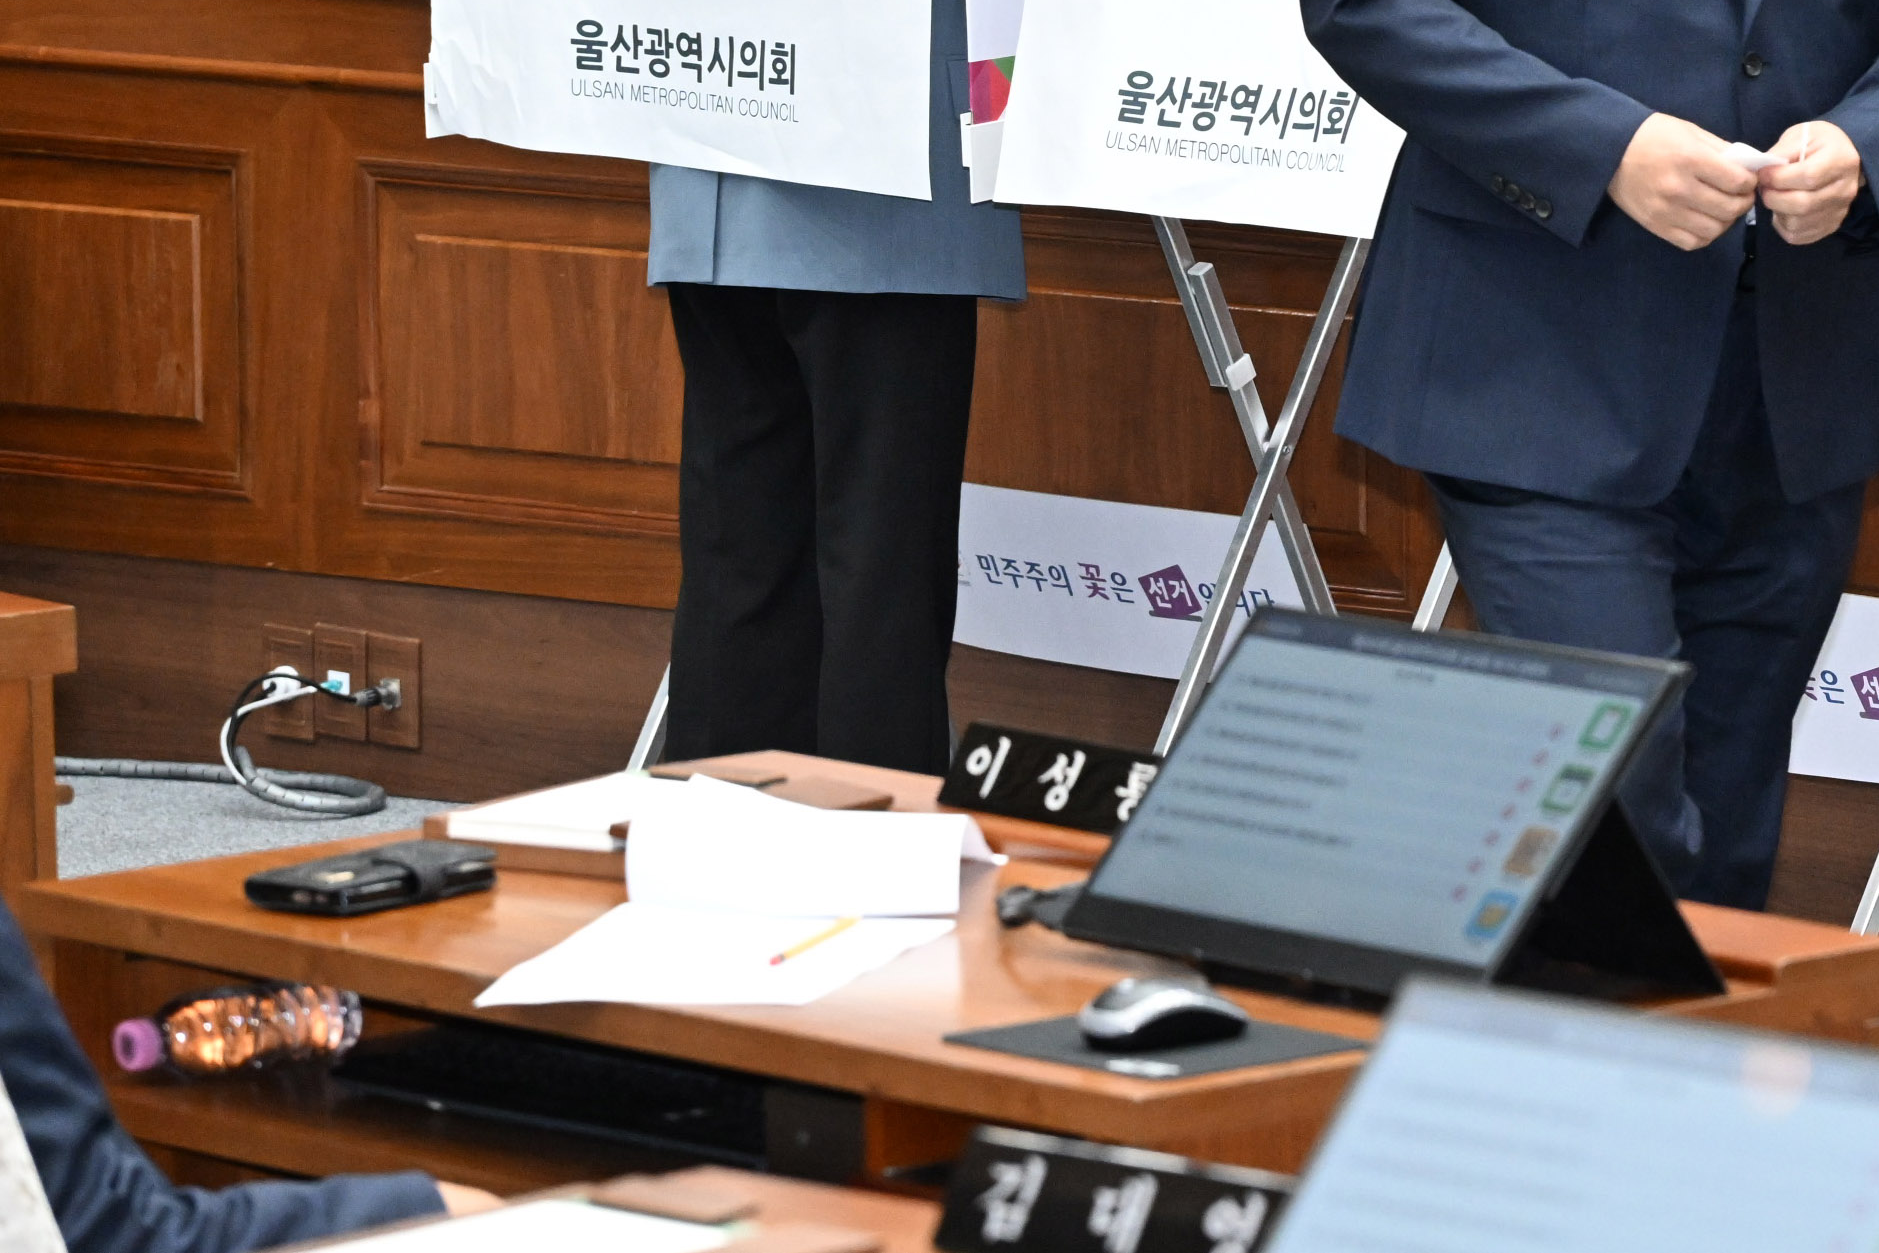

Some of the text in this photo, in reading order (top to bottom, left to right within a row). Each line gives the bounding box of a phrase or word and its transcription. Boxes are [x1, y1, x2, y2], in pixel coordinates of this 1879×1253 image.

[570, 19, 796, 96] 울산광역시의회
[570, 78, 800, 123] ULSAN METROPOLITAN COUNCIL
[1118, 70, 1361, 145] 울산광역시의회
[1105, 130, 1345, 172] ULSAN METROPOLITAN COUNCIL
[975, 554, 1074, 597] 민주주의
[1077, 562, 1135, 604] 꽃은
[1149, 577, 1193, 608] 선거
